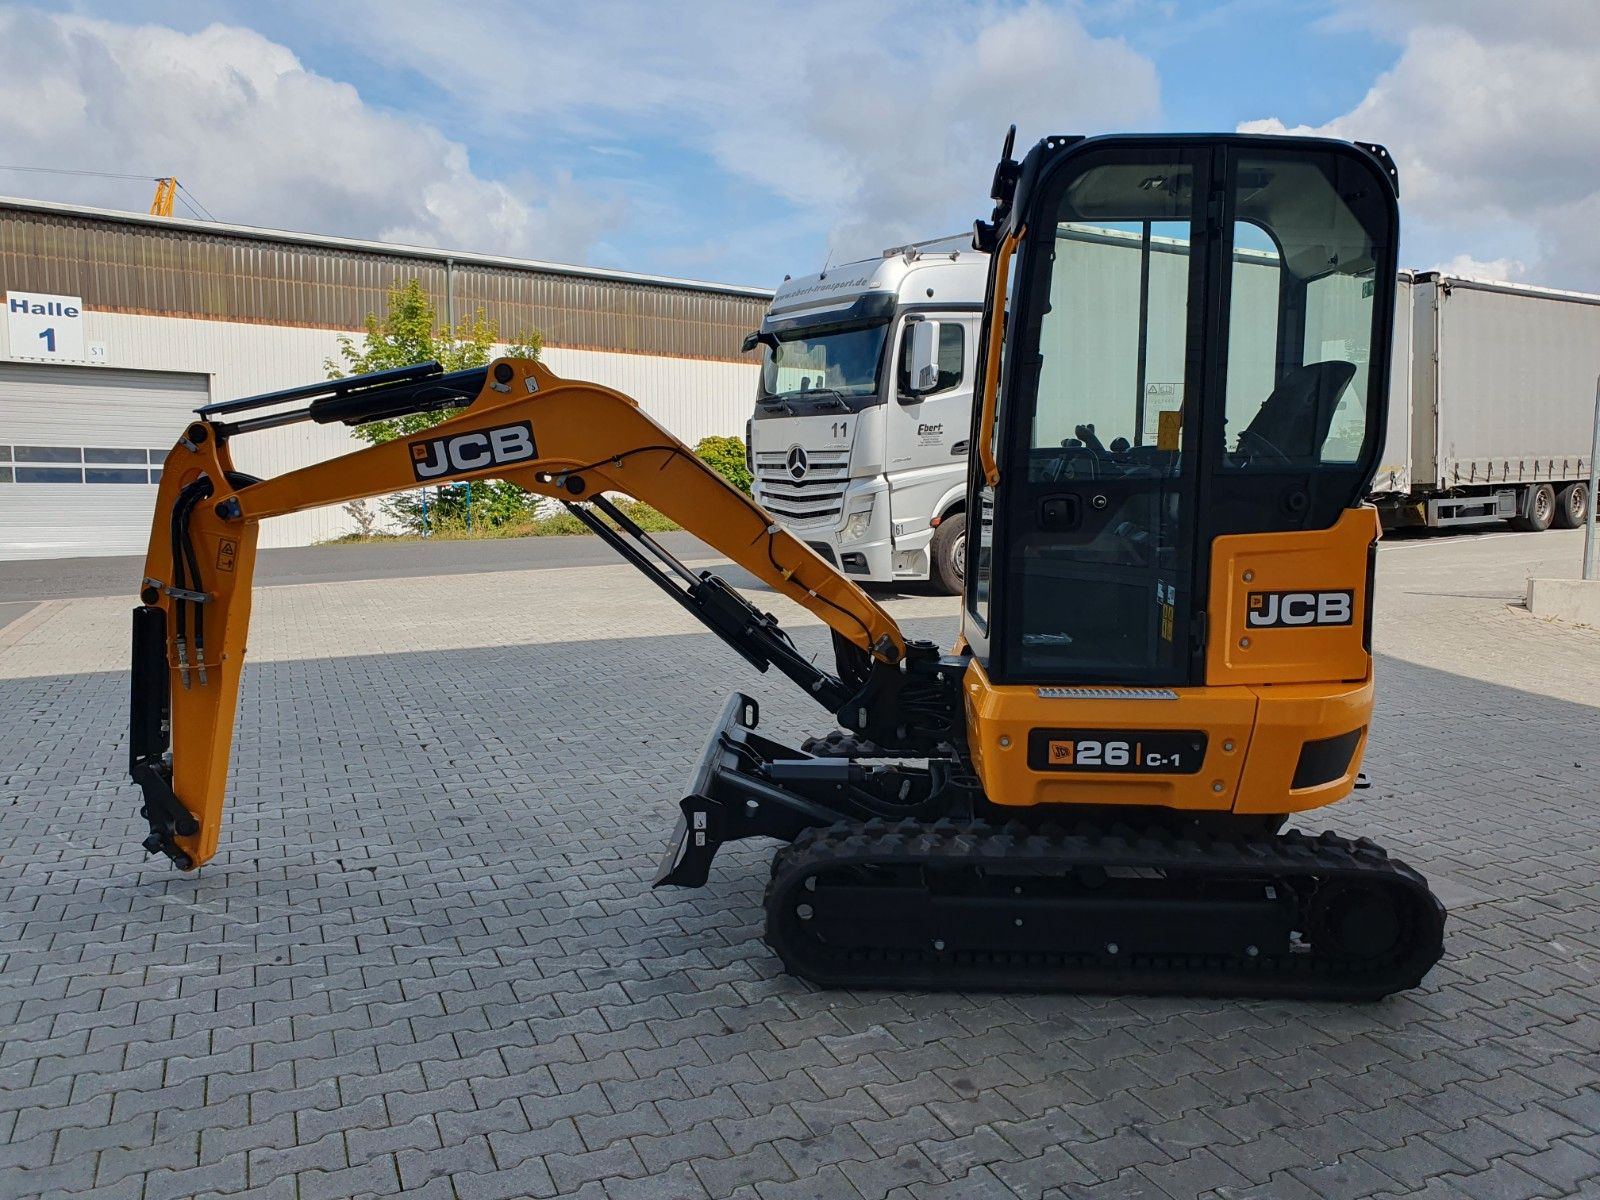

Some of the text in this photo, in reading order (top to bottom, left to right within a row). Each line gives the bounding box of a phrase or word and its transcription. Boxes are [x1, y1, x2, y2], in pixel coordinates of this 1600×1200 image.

[10, 299, 79, 317] Halle
[39, 328, 56, 352] 1
[831, 422, 847, 438] 11
[918, 423, 943, 435] Ebert
[416, 425, 534, 477] JCB
[1249, 592, 1351, 625] JCB
[1076, 741, 1129, 766] 26
[1146, 753, 1180, 767] C-1
